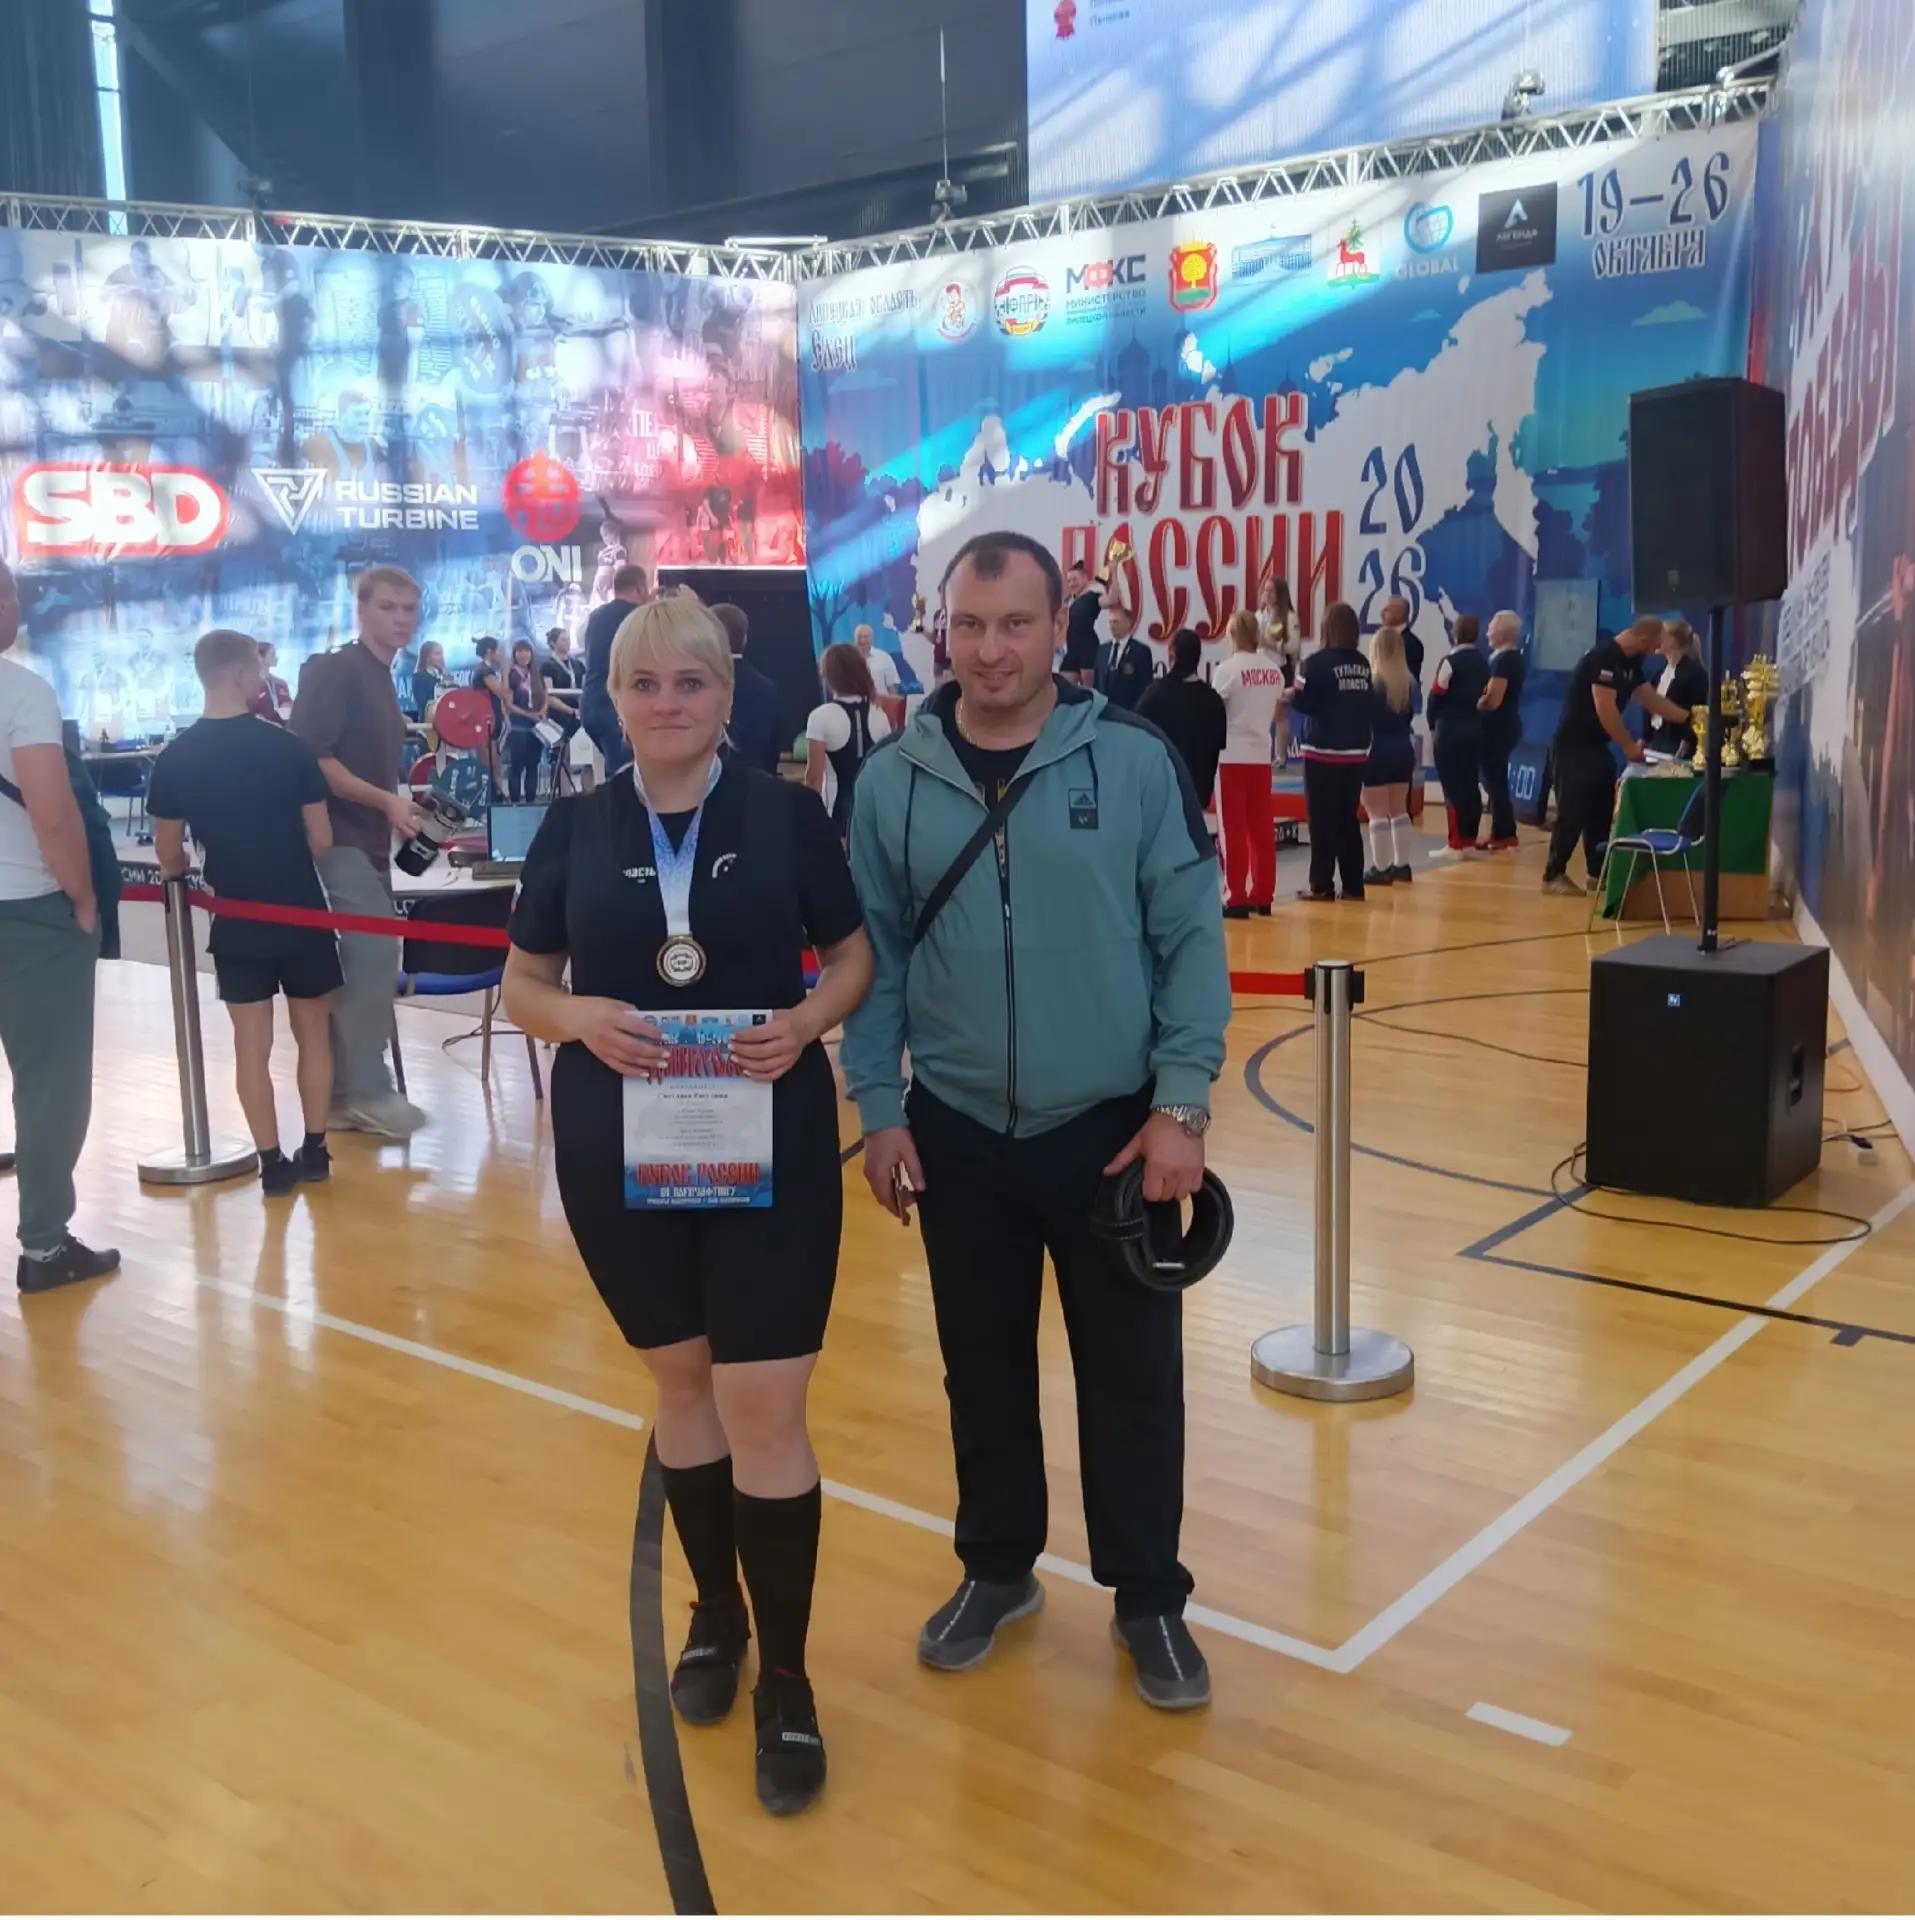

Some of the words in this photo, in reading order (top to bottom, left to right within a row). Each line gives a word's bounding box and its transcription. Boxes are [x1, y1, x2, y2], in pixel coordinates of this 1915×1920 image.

[1593, 228, 1705, 278] ОКТЯБРЯ
[1095, 391, 1308, 517] КУБОК
[22, 469, 222, 547] SBD
[335, 480, 478, 505] RUSSIAN
[1358, 443, 1424, 535] 20
[335, 507, 479, 530] TURBINE
[510, 545, 583, 582] ONI
[1358, 547, 1422, 635] 26
[1240, 667, 1281, 688] МОСКВА
